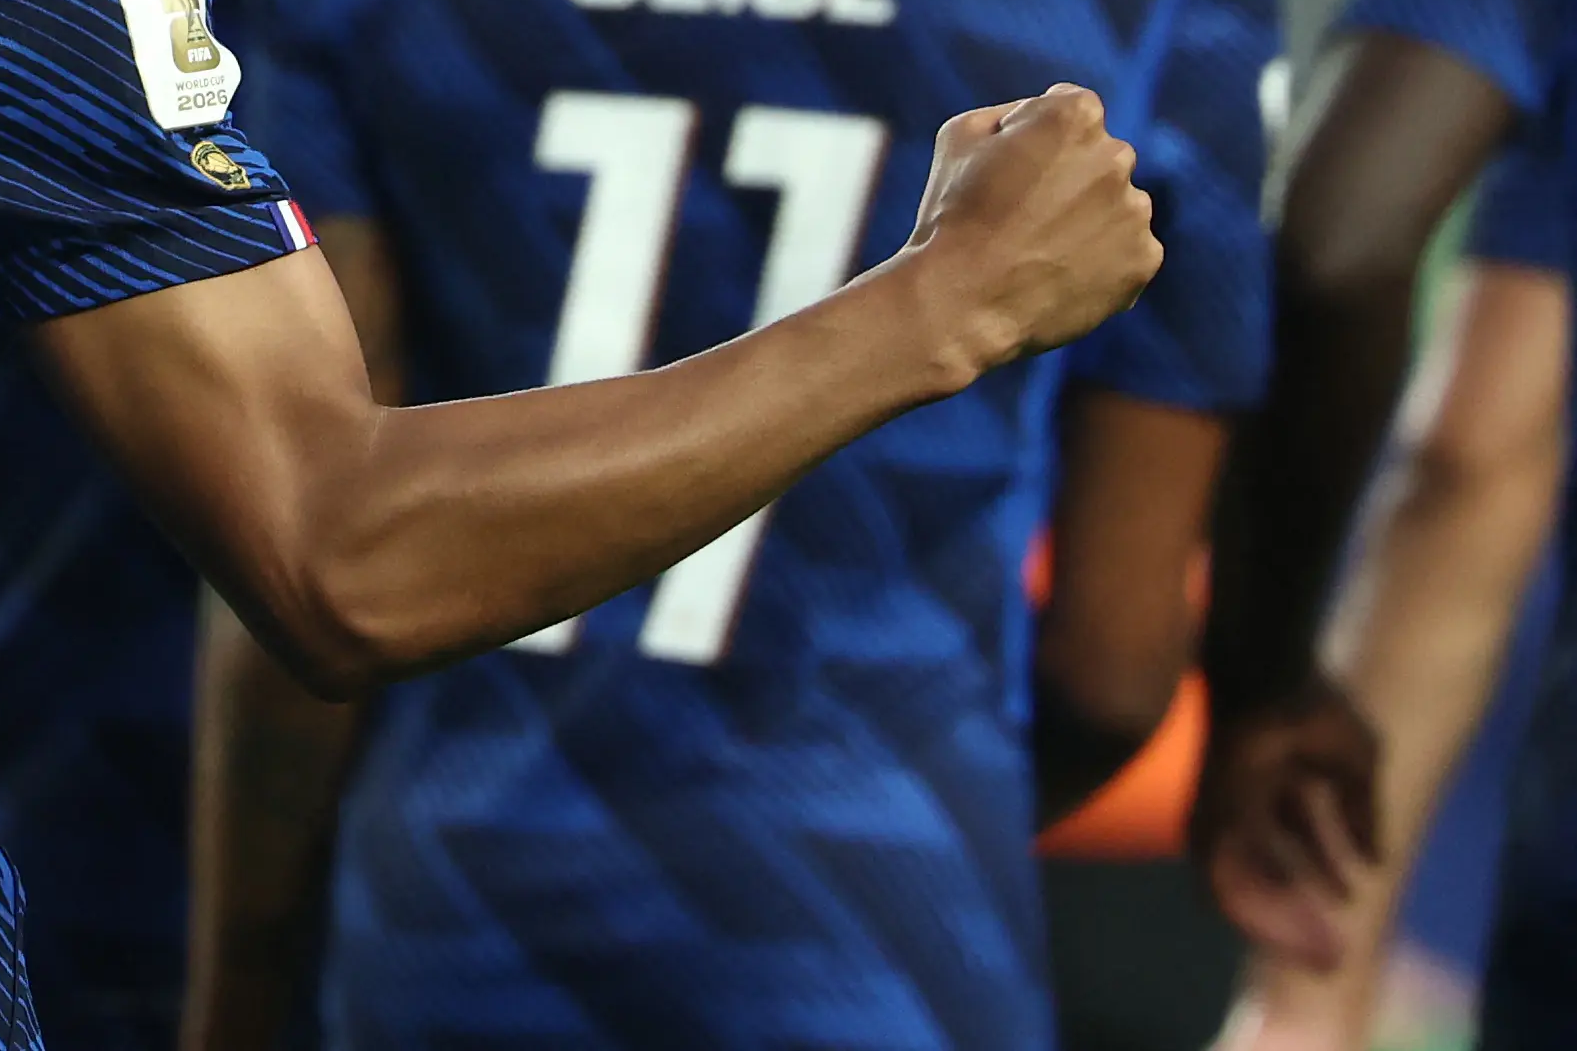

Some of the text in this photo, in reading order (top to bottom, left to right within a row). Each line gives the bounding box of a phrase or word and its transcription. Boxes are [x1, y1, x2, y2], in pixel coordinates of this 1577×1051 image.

[187, 46, 213, 63] FIFA
[175, 74, 226, 91] WORLD CUP
[177, 89, 228, 111] 2026
[499, 89, 894, 666] 11
